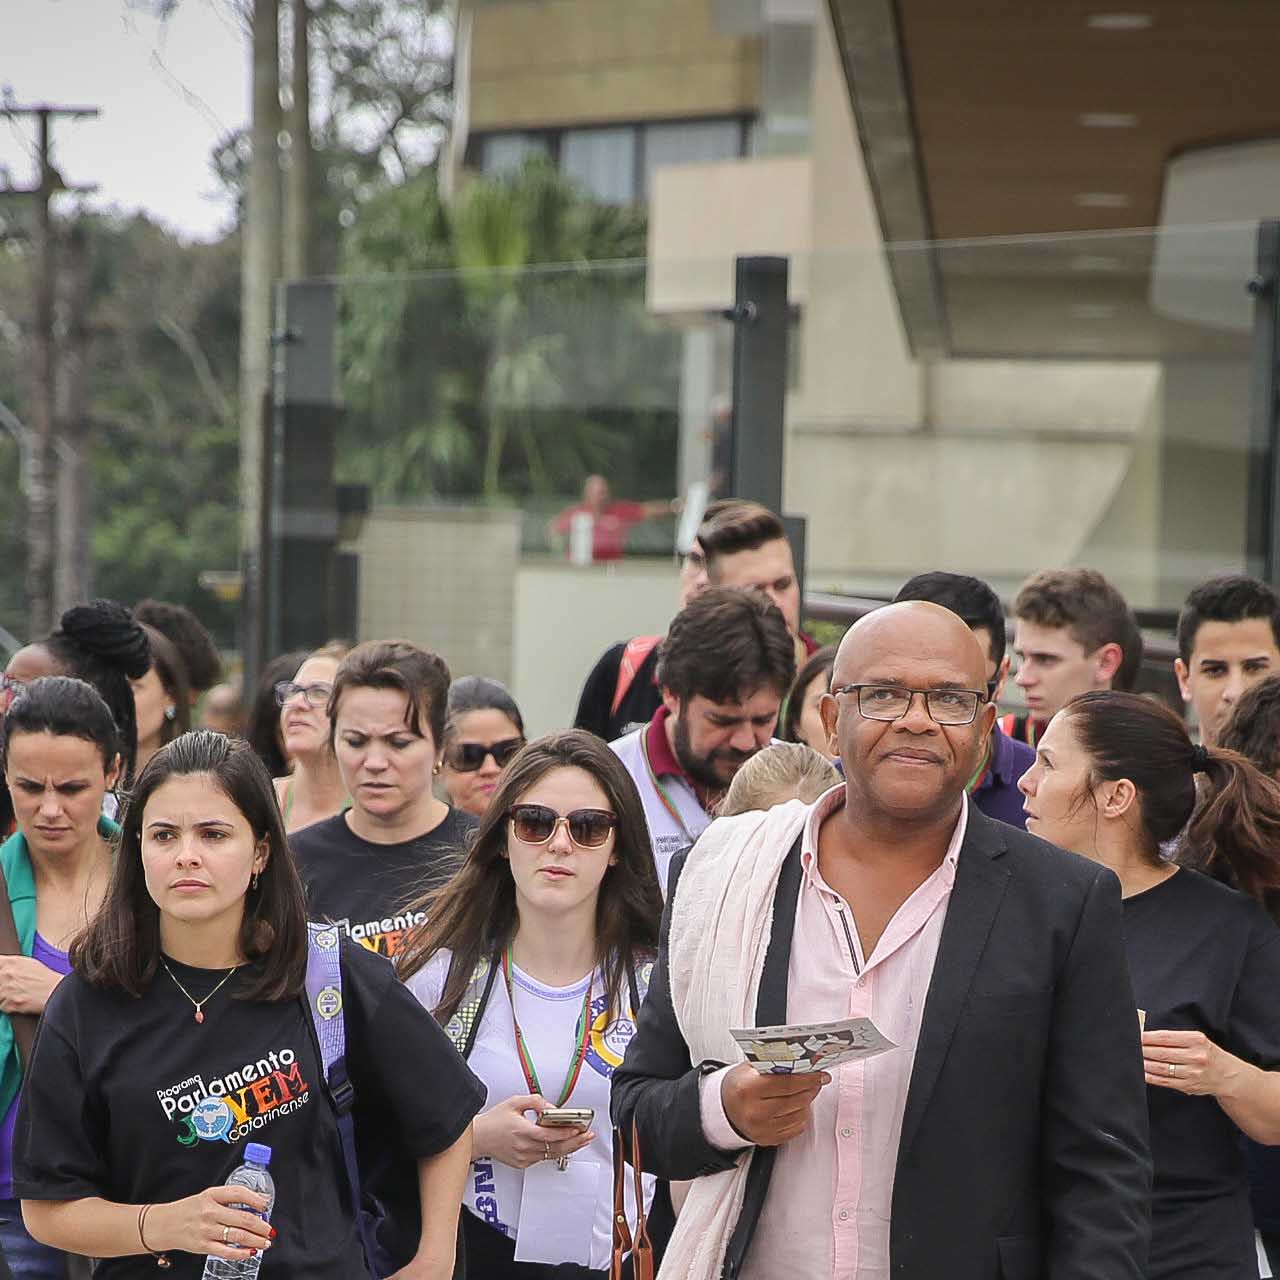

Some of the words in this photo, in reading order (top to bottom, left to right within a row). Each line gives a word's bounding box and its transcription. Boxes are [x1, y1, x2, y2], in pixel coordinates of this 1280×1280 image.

[156, 1074, 202, 1101] Programa
[160, 1048, 295, 1121] Parlamento
[175, 1062, 310, 1148] JOVEM
[228, 1091, 310, 1142] catarinense
